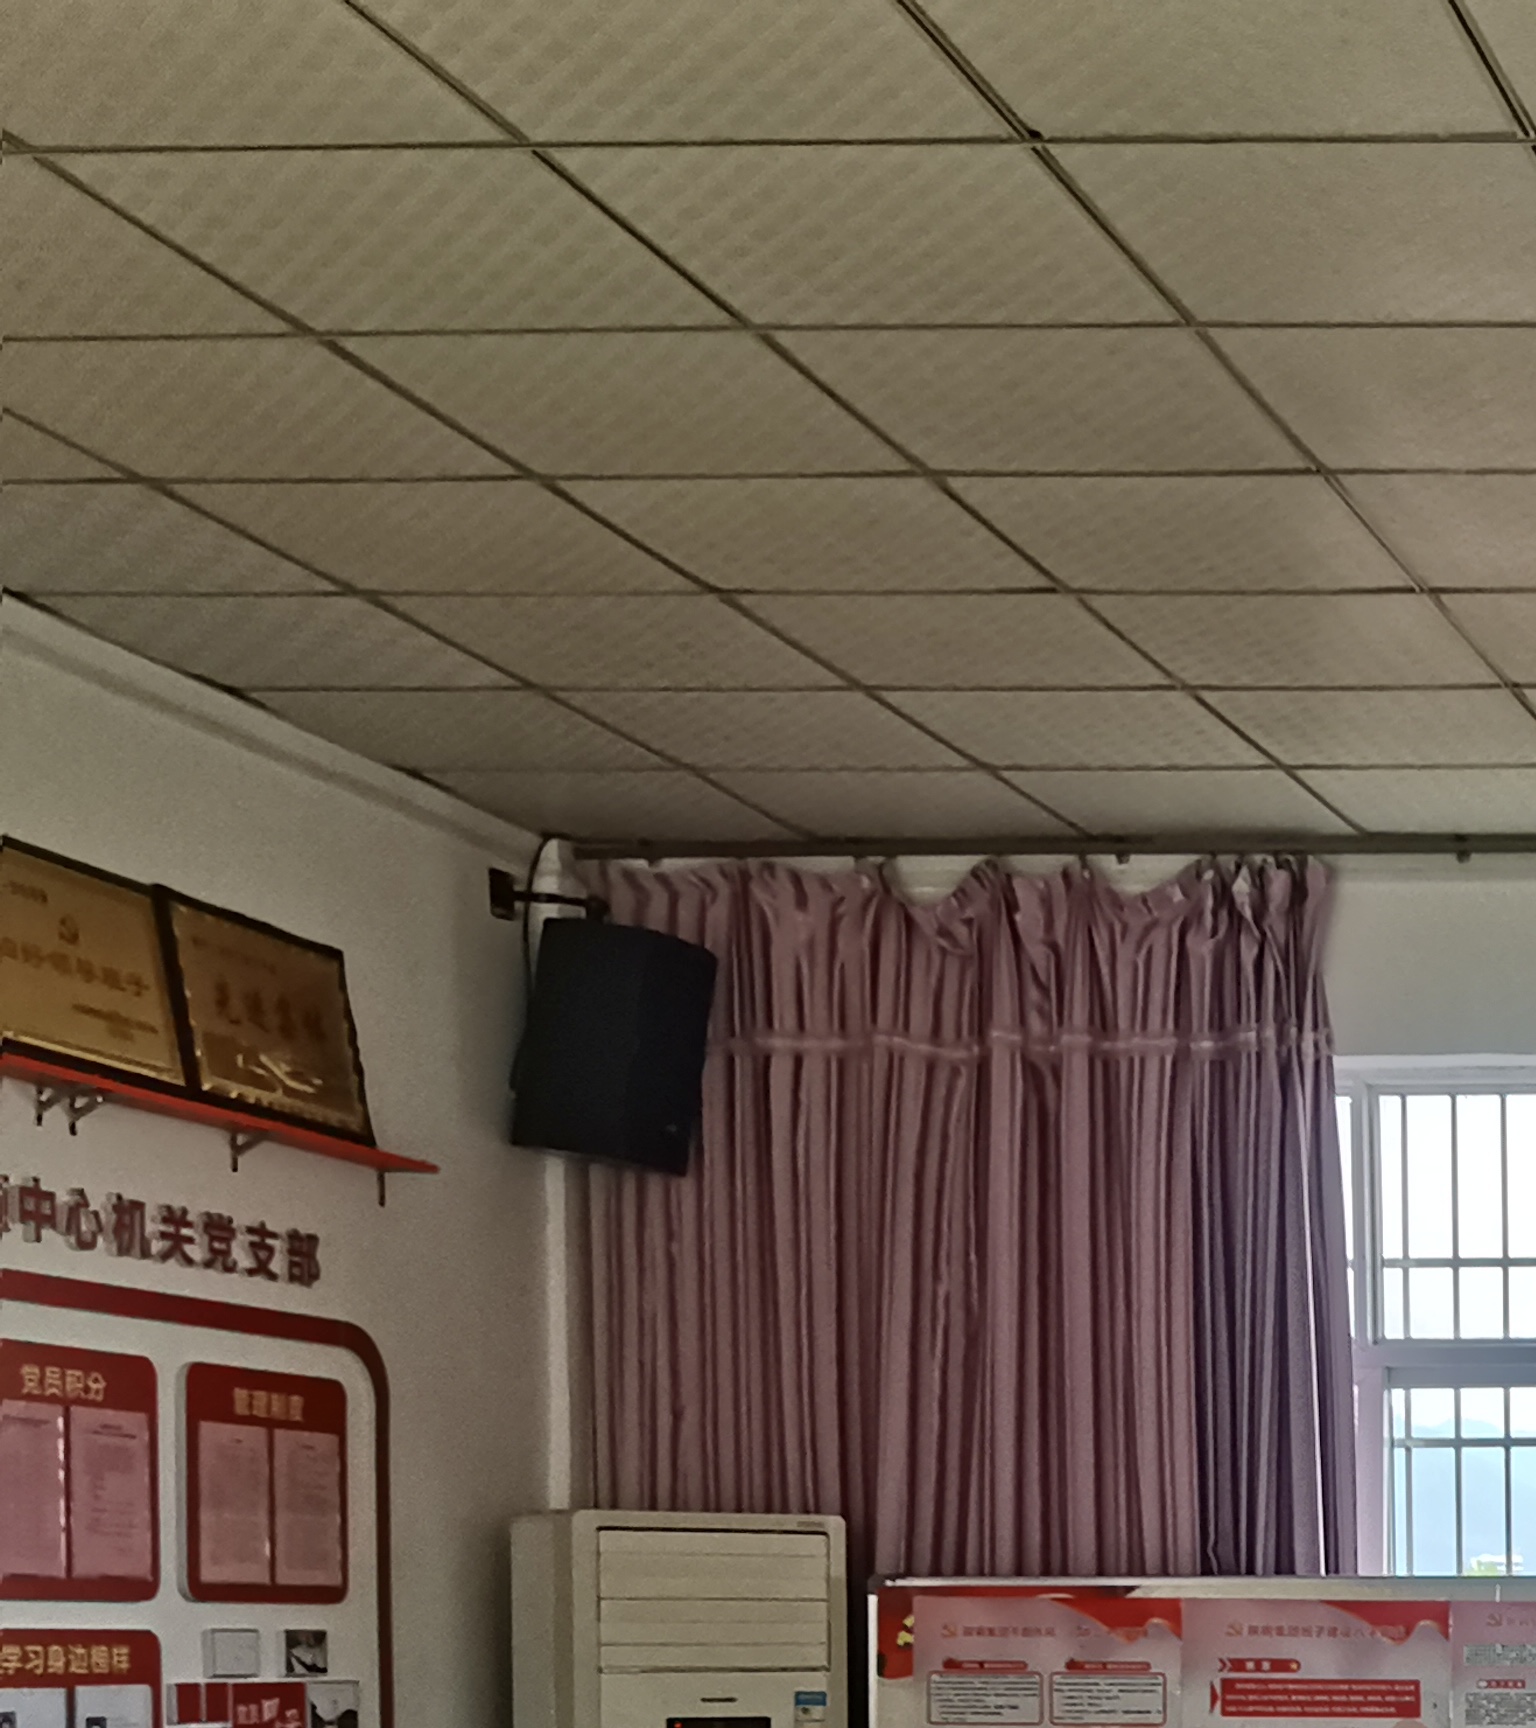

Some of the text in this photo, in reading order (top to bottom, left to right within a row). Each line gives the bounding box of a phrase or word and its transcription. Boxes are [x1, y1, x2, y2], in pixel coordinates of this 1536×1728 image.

[0, 1174, 321, 1288] 中心机关党支部
